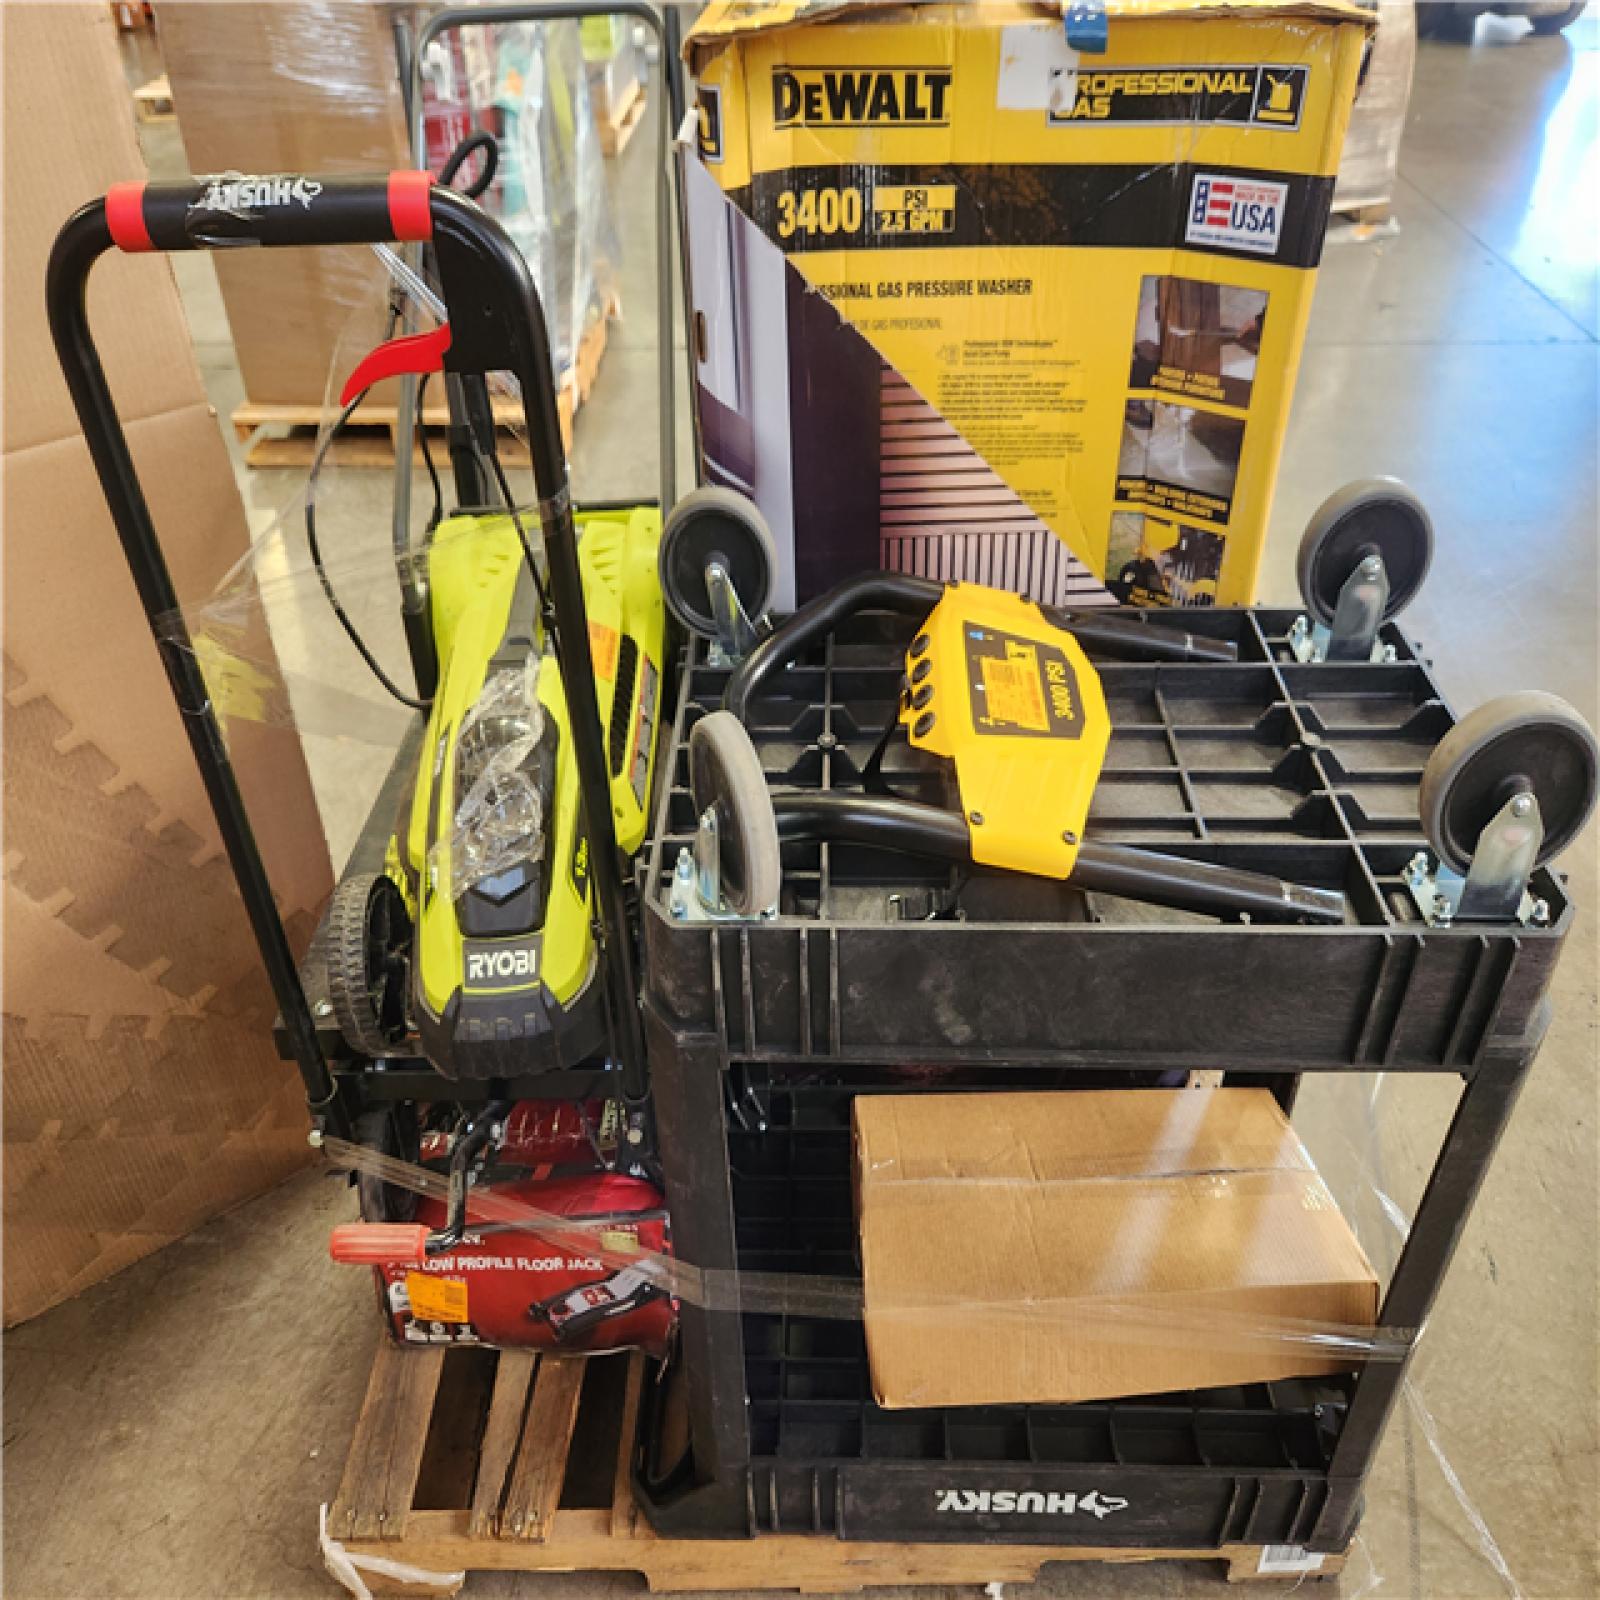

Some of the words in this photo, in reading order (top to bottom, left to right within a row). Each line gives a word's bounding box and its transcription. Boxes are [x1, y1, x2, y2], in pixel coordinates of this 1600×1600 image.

[1077, 72, 1252, 95] ROFESSIONAL
[206, 178, 290, 211] HUSKY
[904, 189, 928, 211] PSI
[776, 186, 862, 238] 3400
[1231, 201, 1277, 236] USA
[816, 282, 872, 300] SSIONAL
[876, 282, 903, 298] GAS
[907, 280, 973, 297] PRESSURE
[977, 279, 1033, 296] WASHER
[467, 949, 537, 982] RYOBI
[423, 1257, 455, 1272] LOW
[457, 1256, 514, 1271] PROFILE
[517, 1256, 565, 1272] FLOOR
[567, 1257, 604, 1272] JACK
[936, 1490, 1077, 1513] HUSKY
